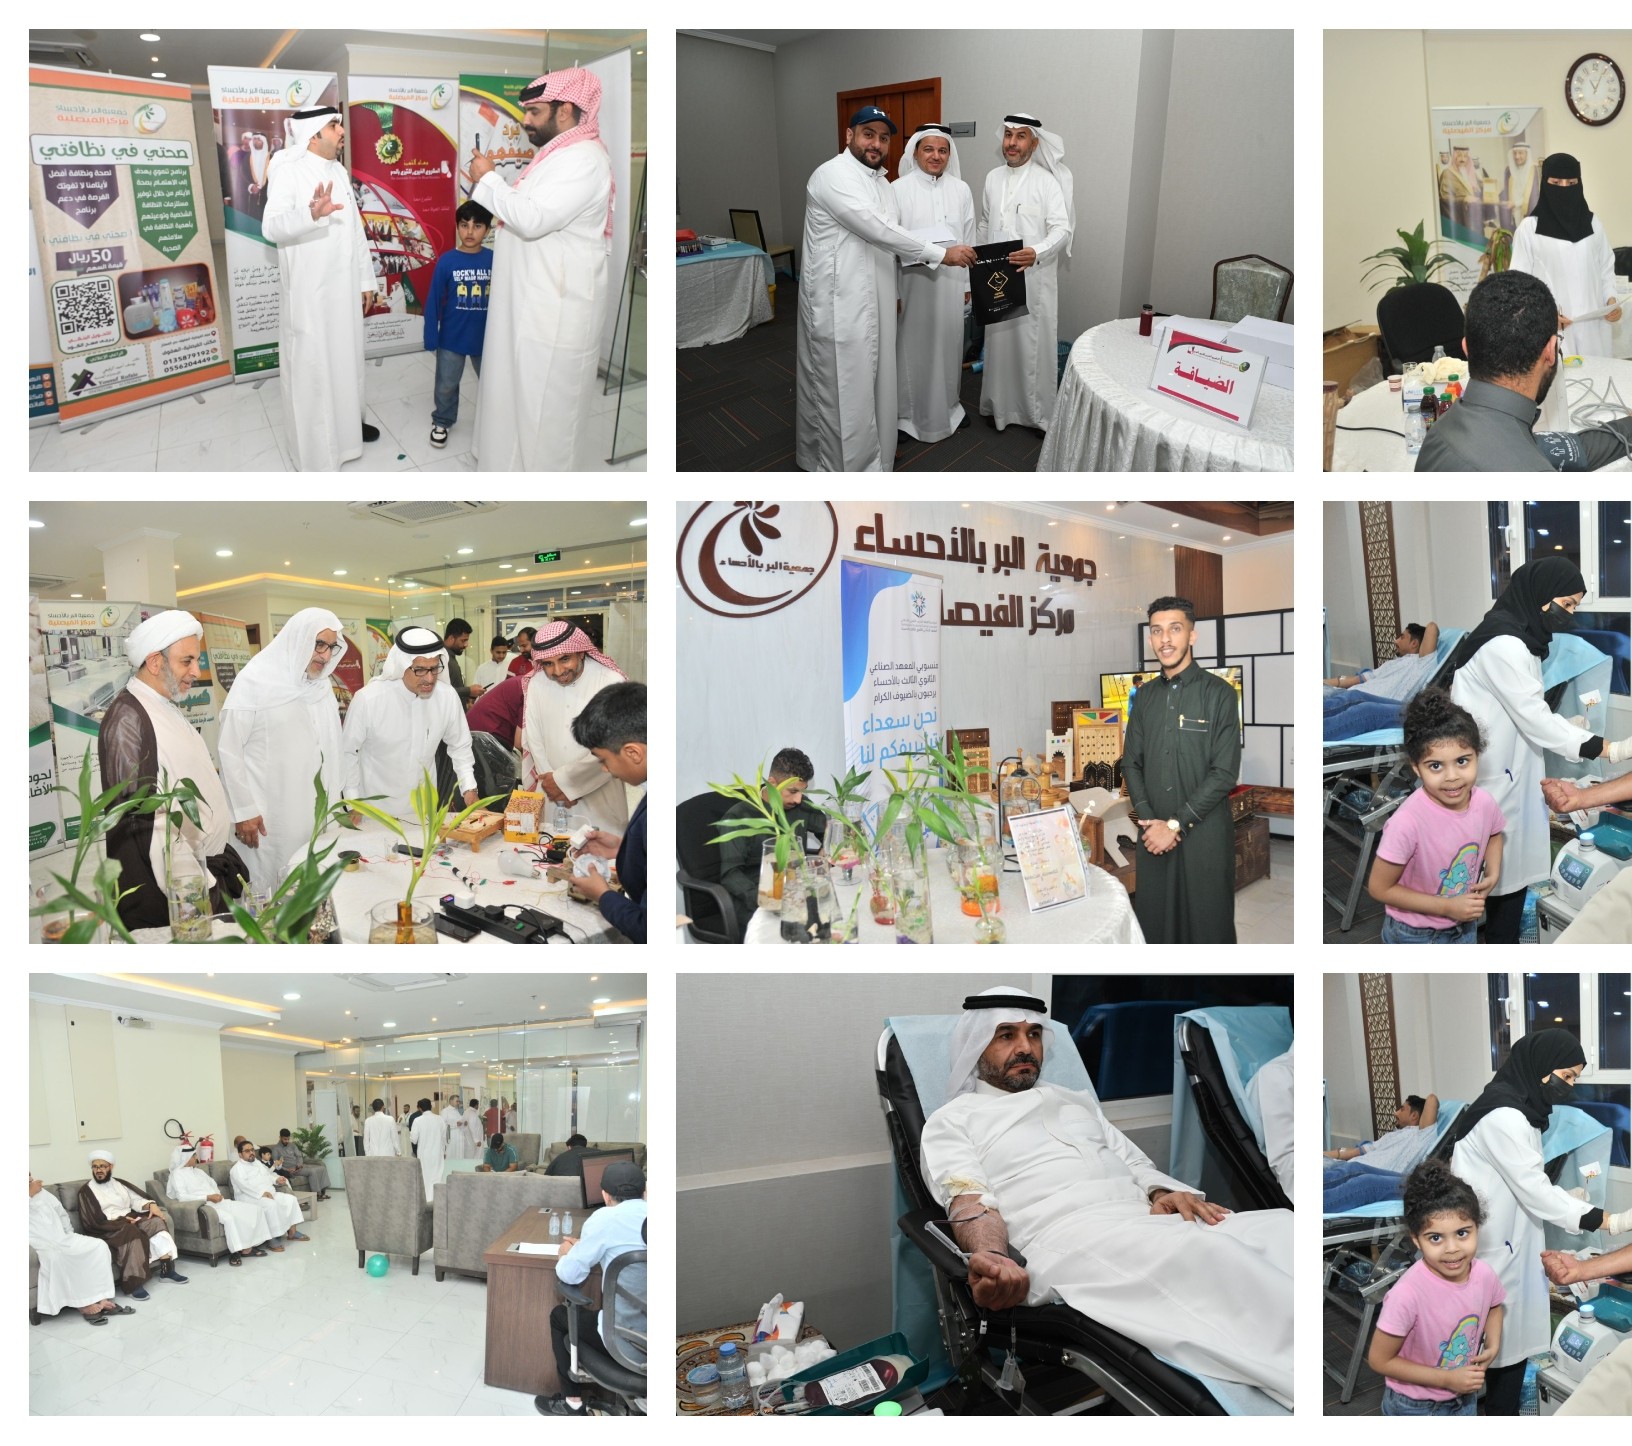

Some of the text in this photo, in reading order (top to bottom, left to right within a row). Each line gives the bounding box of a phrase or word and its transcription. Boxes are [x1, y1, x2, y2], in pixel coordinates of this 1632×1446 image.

[39, 140, 189, 161] صحتي في نظافتي
[68, 249, 112, 264] 50 ريال
[452, 269, 488, 277] ROCK'N ALL
[163, 349, 210, 365] 0135879192
[164, 357, 211, 373] 0556204449
[1174, 361, 1235, 395] الضيافة
[853, 512, 1097, 587] جمعية البر بالأحساء
[718, 555, 815, 576] جمعية البر بالأحساء
[1029, 594, 1075, 636] مركز
[869, 661, 894, 675] الصناعي
[874, 691, 892, 706] الكرام
[892, 690, 917, 702] بالضيوف
[863, 706, 937, 735] نحن سعداء
[860, 743, 875, 764] لنا
